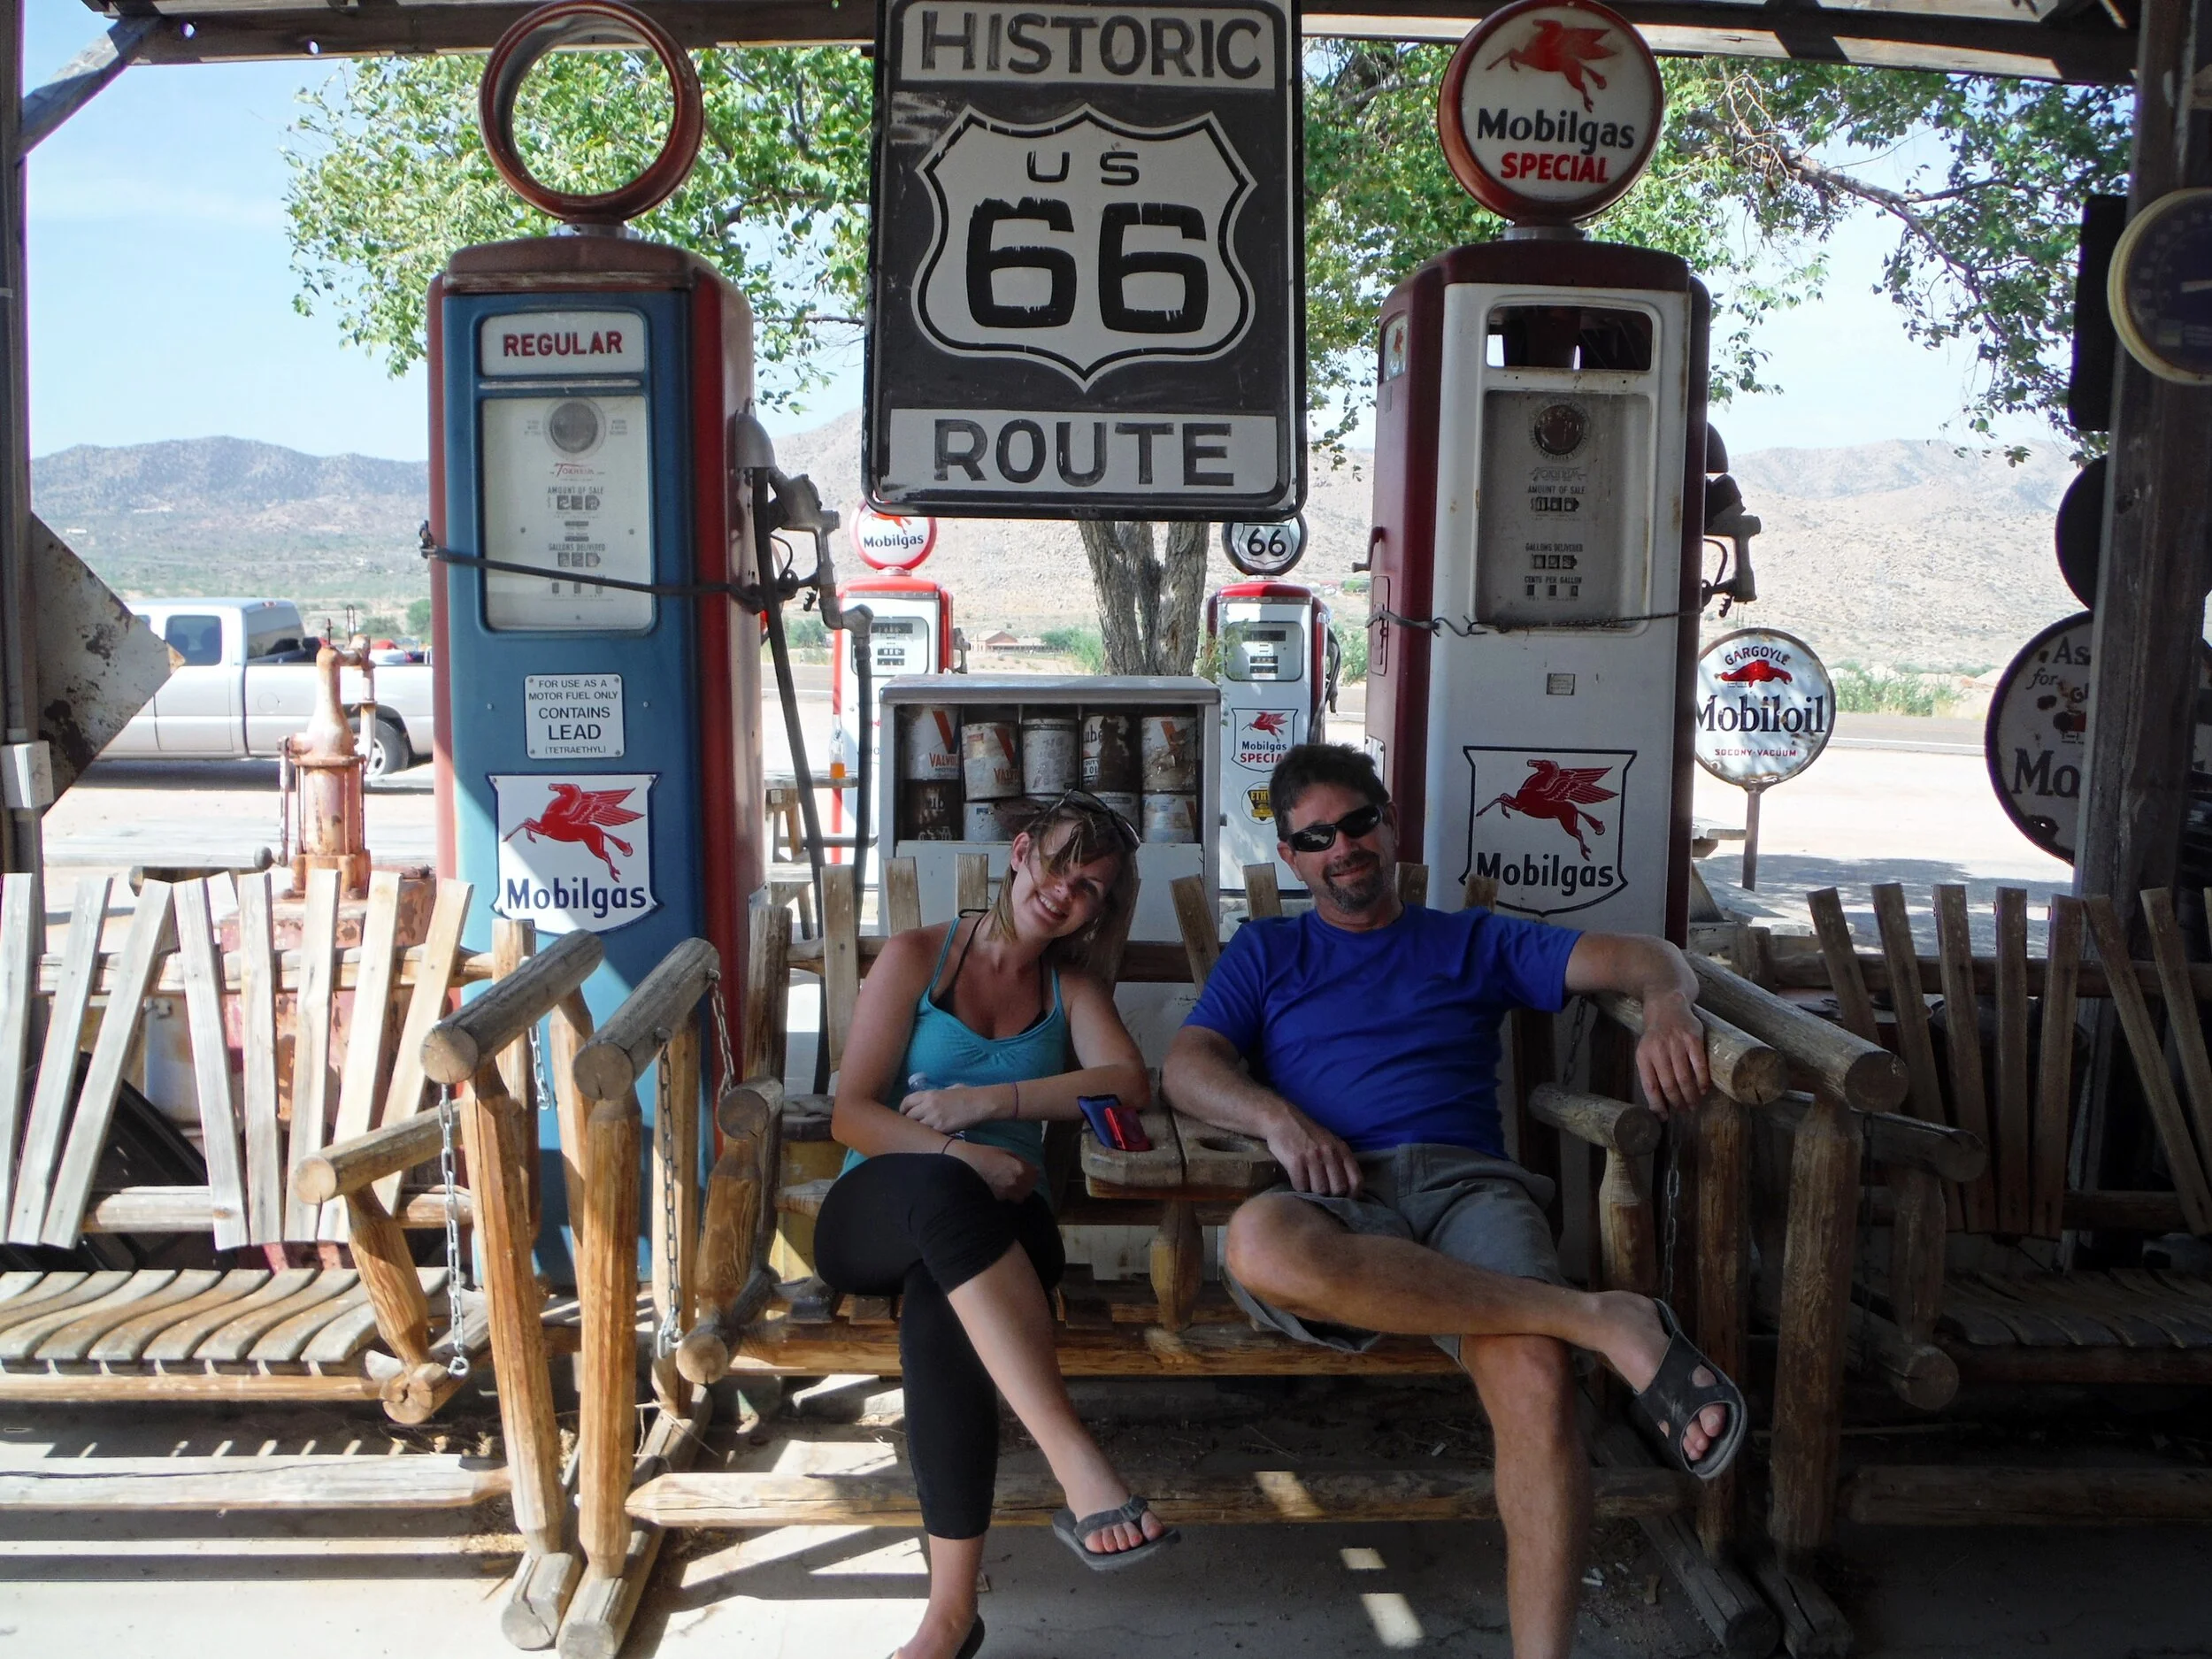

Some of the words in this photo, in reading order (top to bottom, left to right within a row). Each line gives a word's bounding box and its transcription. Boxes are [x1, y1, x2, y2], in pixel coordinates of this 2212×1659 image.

[921, 11, 1261, 79] HISTORIC
[1477, 108, 1635, 157] Mobilgas
[1500, 152, 1609, 184] SPECIAL
[965, 196, 1210, 334] 66
[503, 331, 623, 357] REGULAR
[933, 419, 1235, 487] ROUTE
[864, 534, 924, 549] Mobilgas
[1247, 527, 1286, 557] 66
[1525, 542, 1553, 551] GALLONS
[1554, 543, 1583, 552] DELIVERED
[1724, 646, 1792, 666] GARGOYLE
[539, 679, 558, 688] FOR
[561, 679, 580, 688] USE
[584, 679, 597, 687] AS
[600, 679, 608, 687] A
[2026, 668, 2058, 690] for
[528, 692, 563, 701] MOTOR
[565, 691, 590, 700] FUEL
[594, 691, 618, 700] ONLY
[538, 707, 611, 719] CONTAINS
[1696, 695, 1826, 733] Mobiloil
[548, 724, 602, 741] LEAD
[545, 746, 607, 755] (TETRAETHYL)
[1241, 741, 1287, 753] Mobilgas
[1240, 753, 1283, 764] SPECIA
[1477, 852, 1614, 896] Mobilgas
[506, 877, 647, 918] Mobilgas
